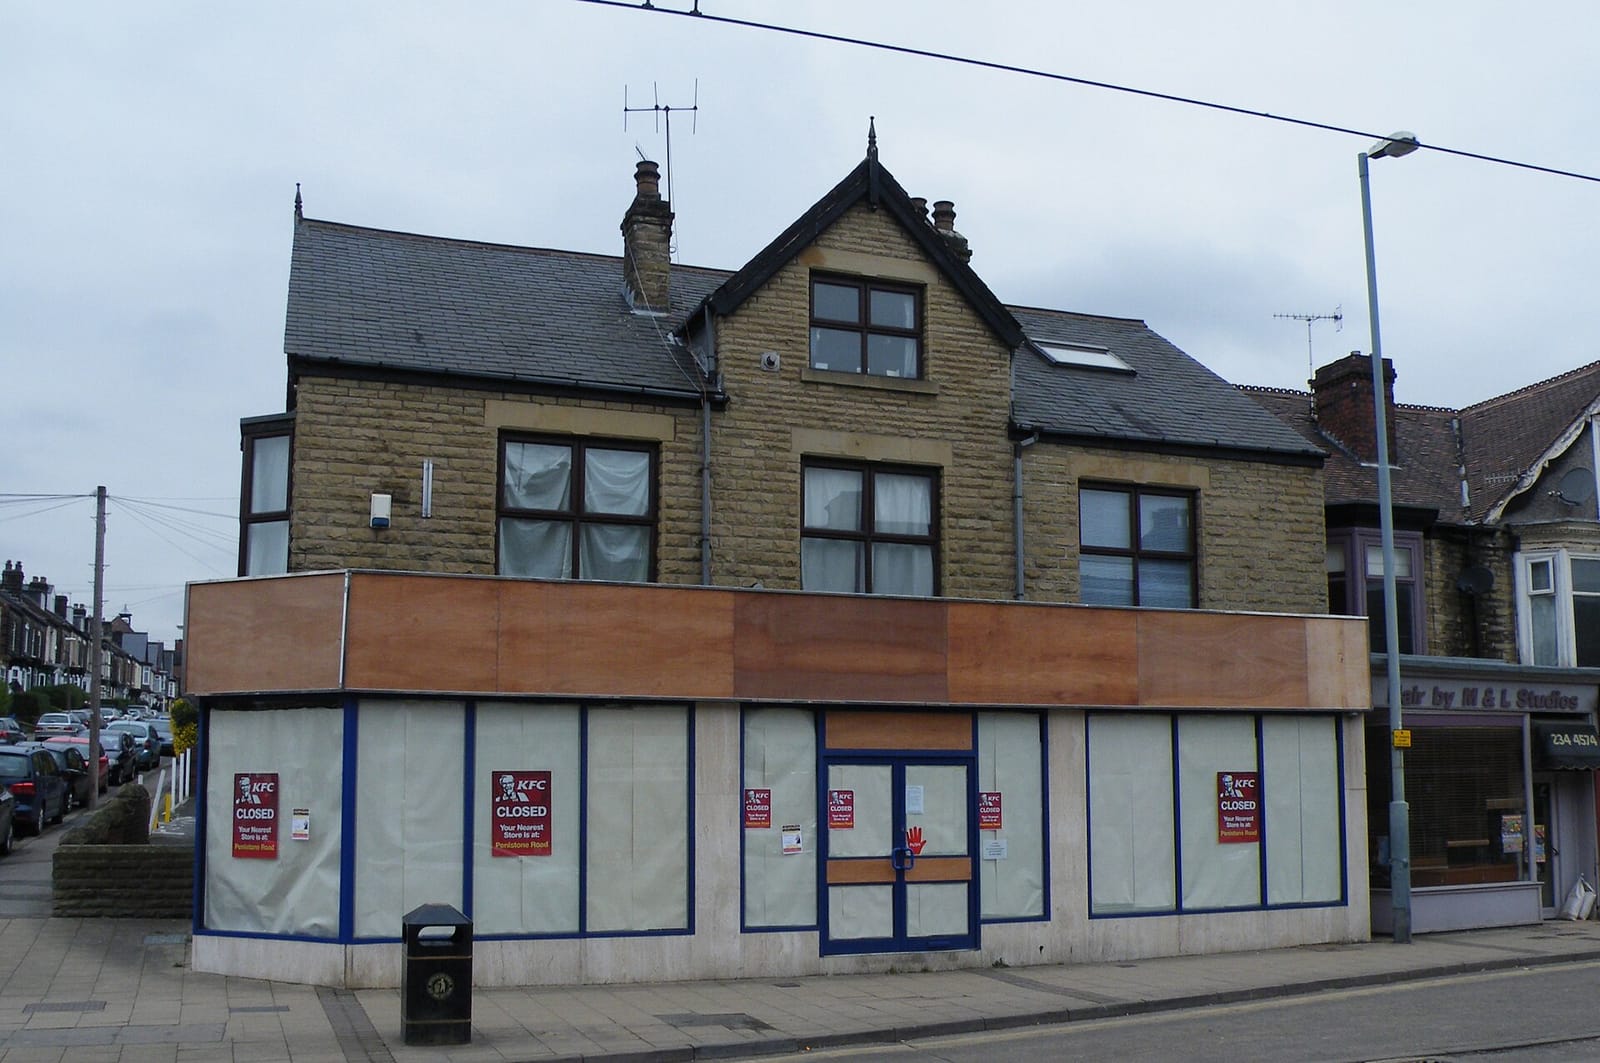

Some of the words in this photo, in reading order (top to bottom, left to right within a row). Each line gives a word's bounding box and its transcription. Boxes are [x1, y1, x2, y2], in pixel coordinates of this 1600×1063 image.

[1400, 684, 1425, 706] air
[1431, 686, 1455, 709] by
[1462, 687, 1479, 707] M
[1481, 688, 1495, 708] &
[1500, 688, 1511, 708] L
[1515, 688, 1579, 710] Studios
[1551, 733, 1571, 746] 234
[1573, 733, 1598, 746] 4574
[252, 782, 274, 792] KFC
[517, 780, 547, 790] KFC
[1235, 779, 1255, 788] KFC
[1221, 801, 1256, 810] CLOSED
[236, 808, 274, 819] CLOSED
[496, 806, 547, 817] CLOSED
[495, 841, 529, 849] Penistone
